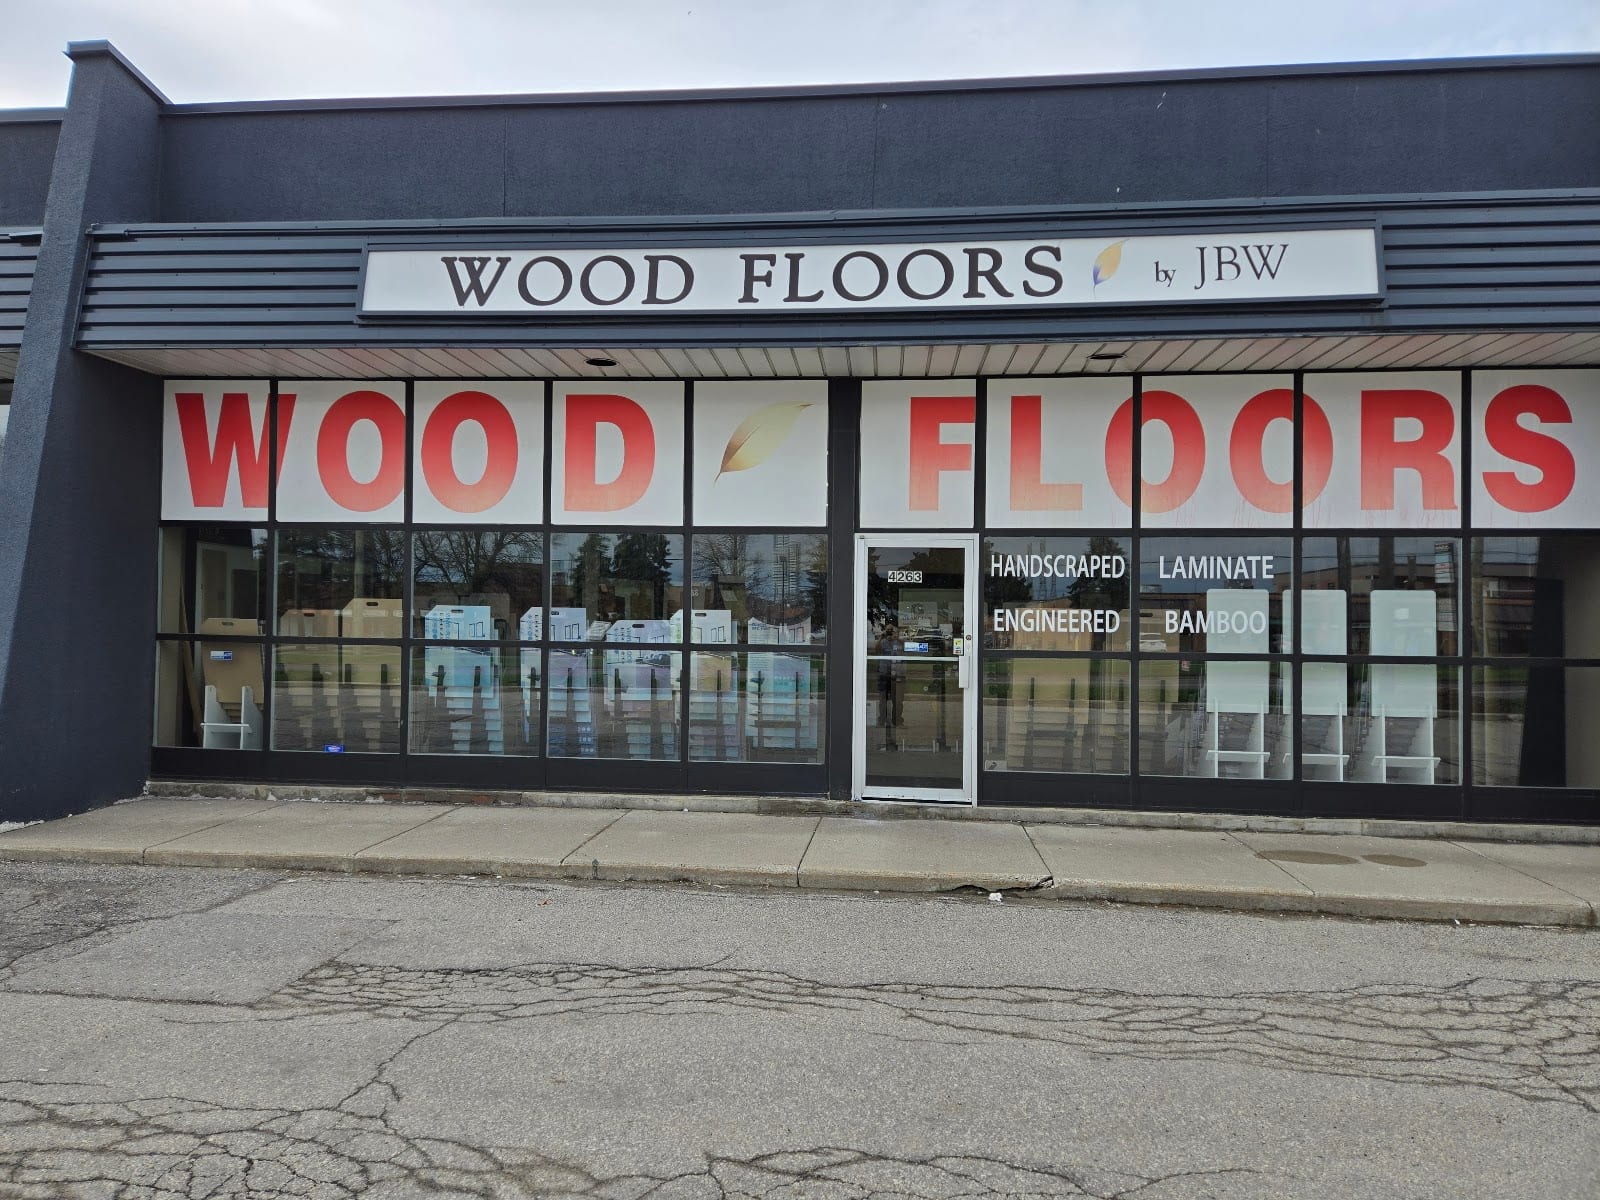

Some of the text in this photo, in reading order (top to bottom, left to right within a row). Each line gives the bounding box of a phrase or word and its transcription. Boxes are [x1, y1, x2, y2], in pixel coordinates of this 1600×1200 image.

[441, 243, 1289, 307] WOOD FLOORS by JBW
[175, 384, 1575, 513] WOOD FLOORS
[888, 571, 922, 582] 4263
[991, 554, 1125, 579] HANDSCRAPED
[1159, 555, 1274, 580] LAMINATE
[994, 608, 1120, 633] ENGINEERED
[1165, 610, 1267, 634] BAMBOO
